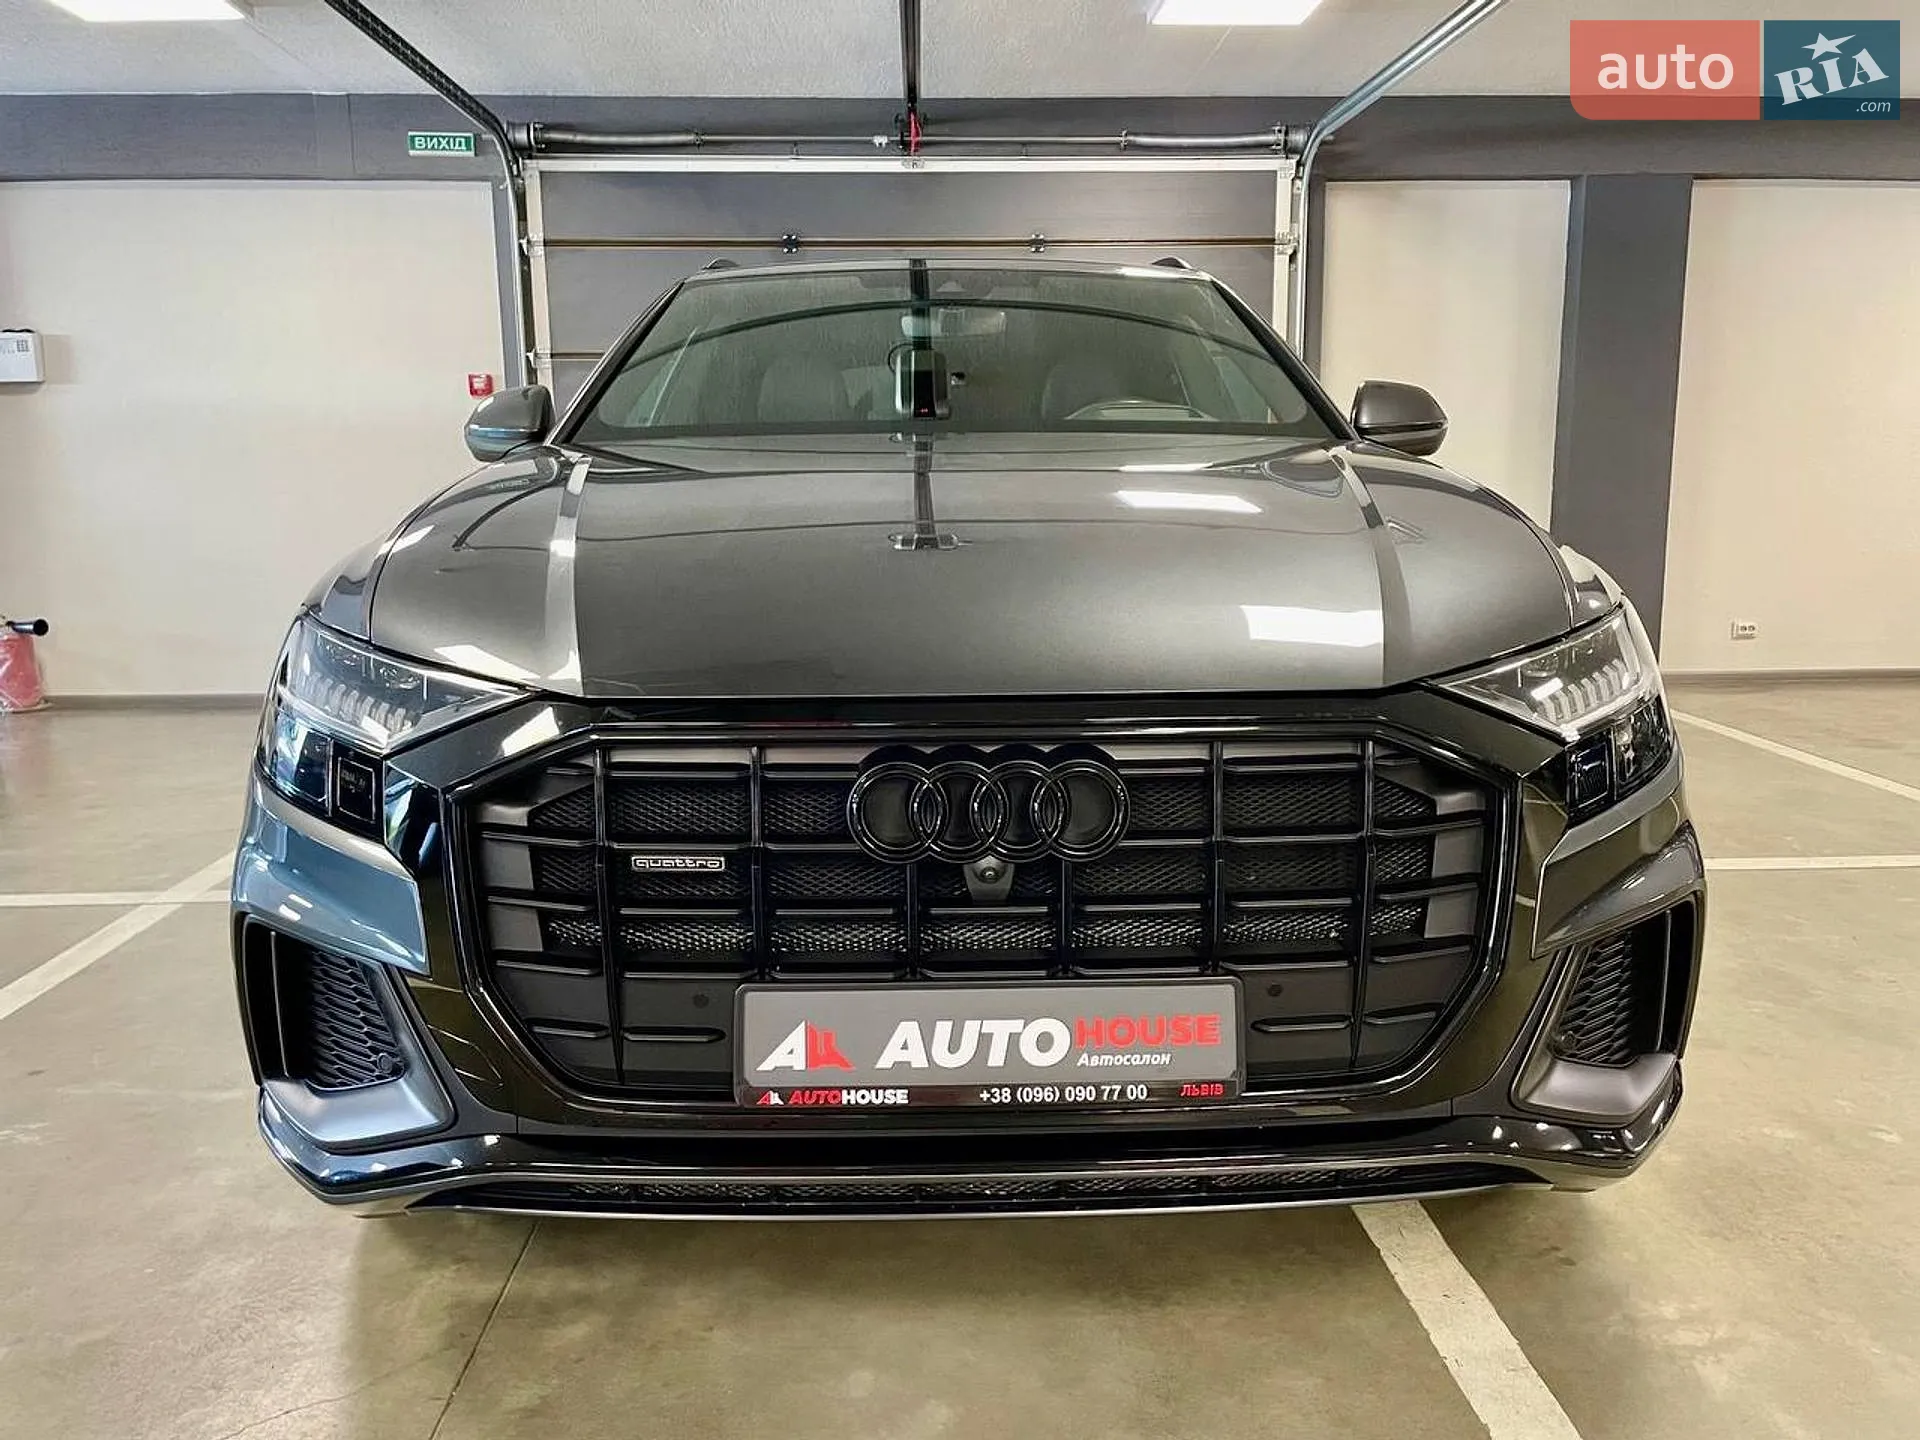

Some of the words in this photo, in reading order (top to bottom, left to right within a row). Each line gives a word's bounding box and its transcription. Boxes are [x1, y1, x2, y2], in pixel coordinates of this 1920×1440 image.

[415, 136, 467, 150] ВИХІД
[635, 859, 721, 869] quattro
[1077, 1053, 1172, 1067] Автосалон
[979, 1087, 1012, 1104] +38
[1016, 1086, 1060, 1103] (096)
[1065, 1085, 1096, 1101] 090
[1101, 1085, 1122, 1100] 77
[1126, 1084, 1148, 1100] 00
[1180, 1083, 1225, 1097] ЛЬВІВ
